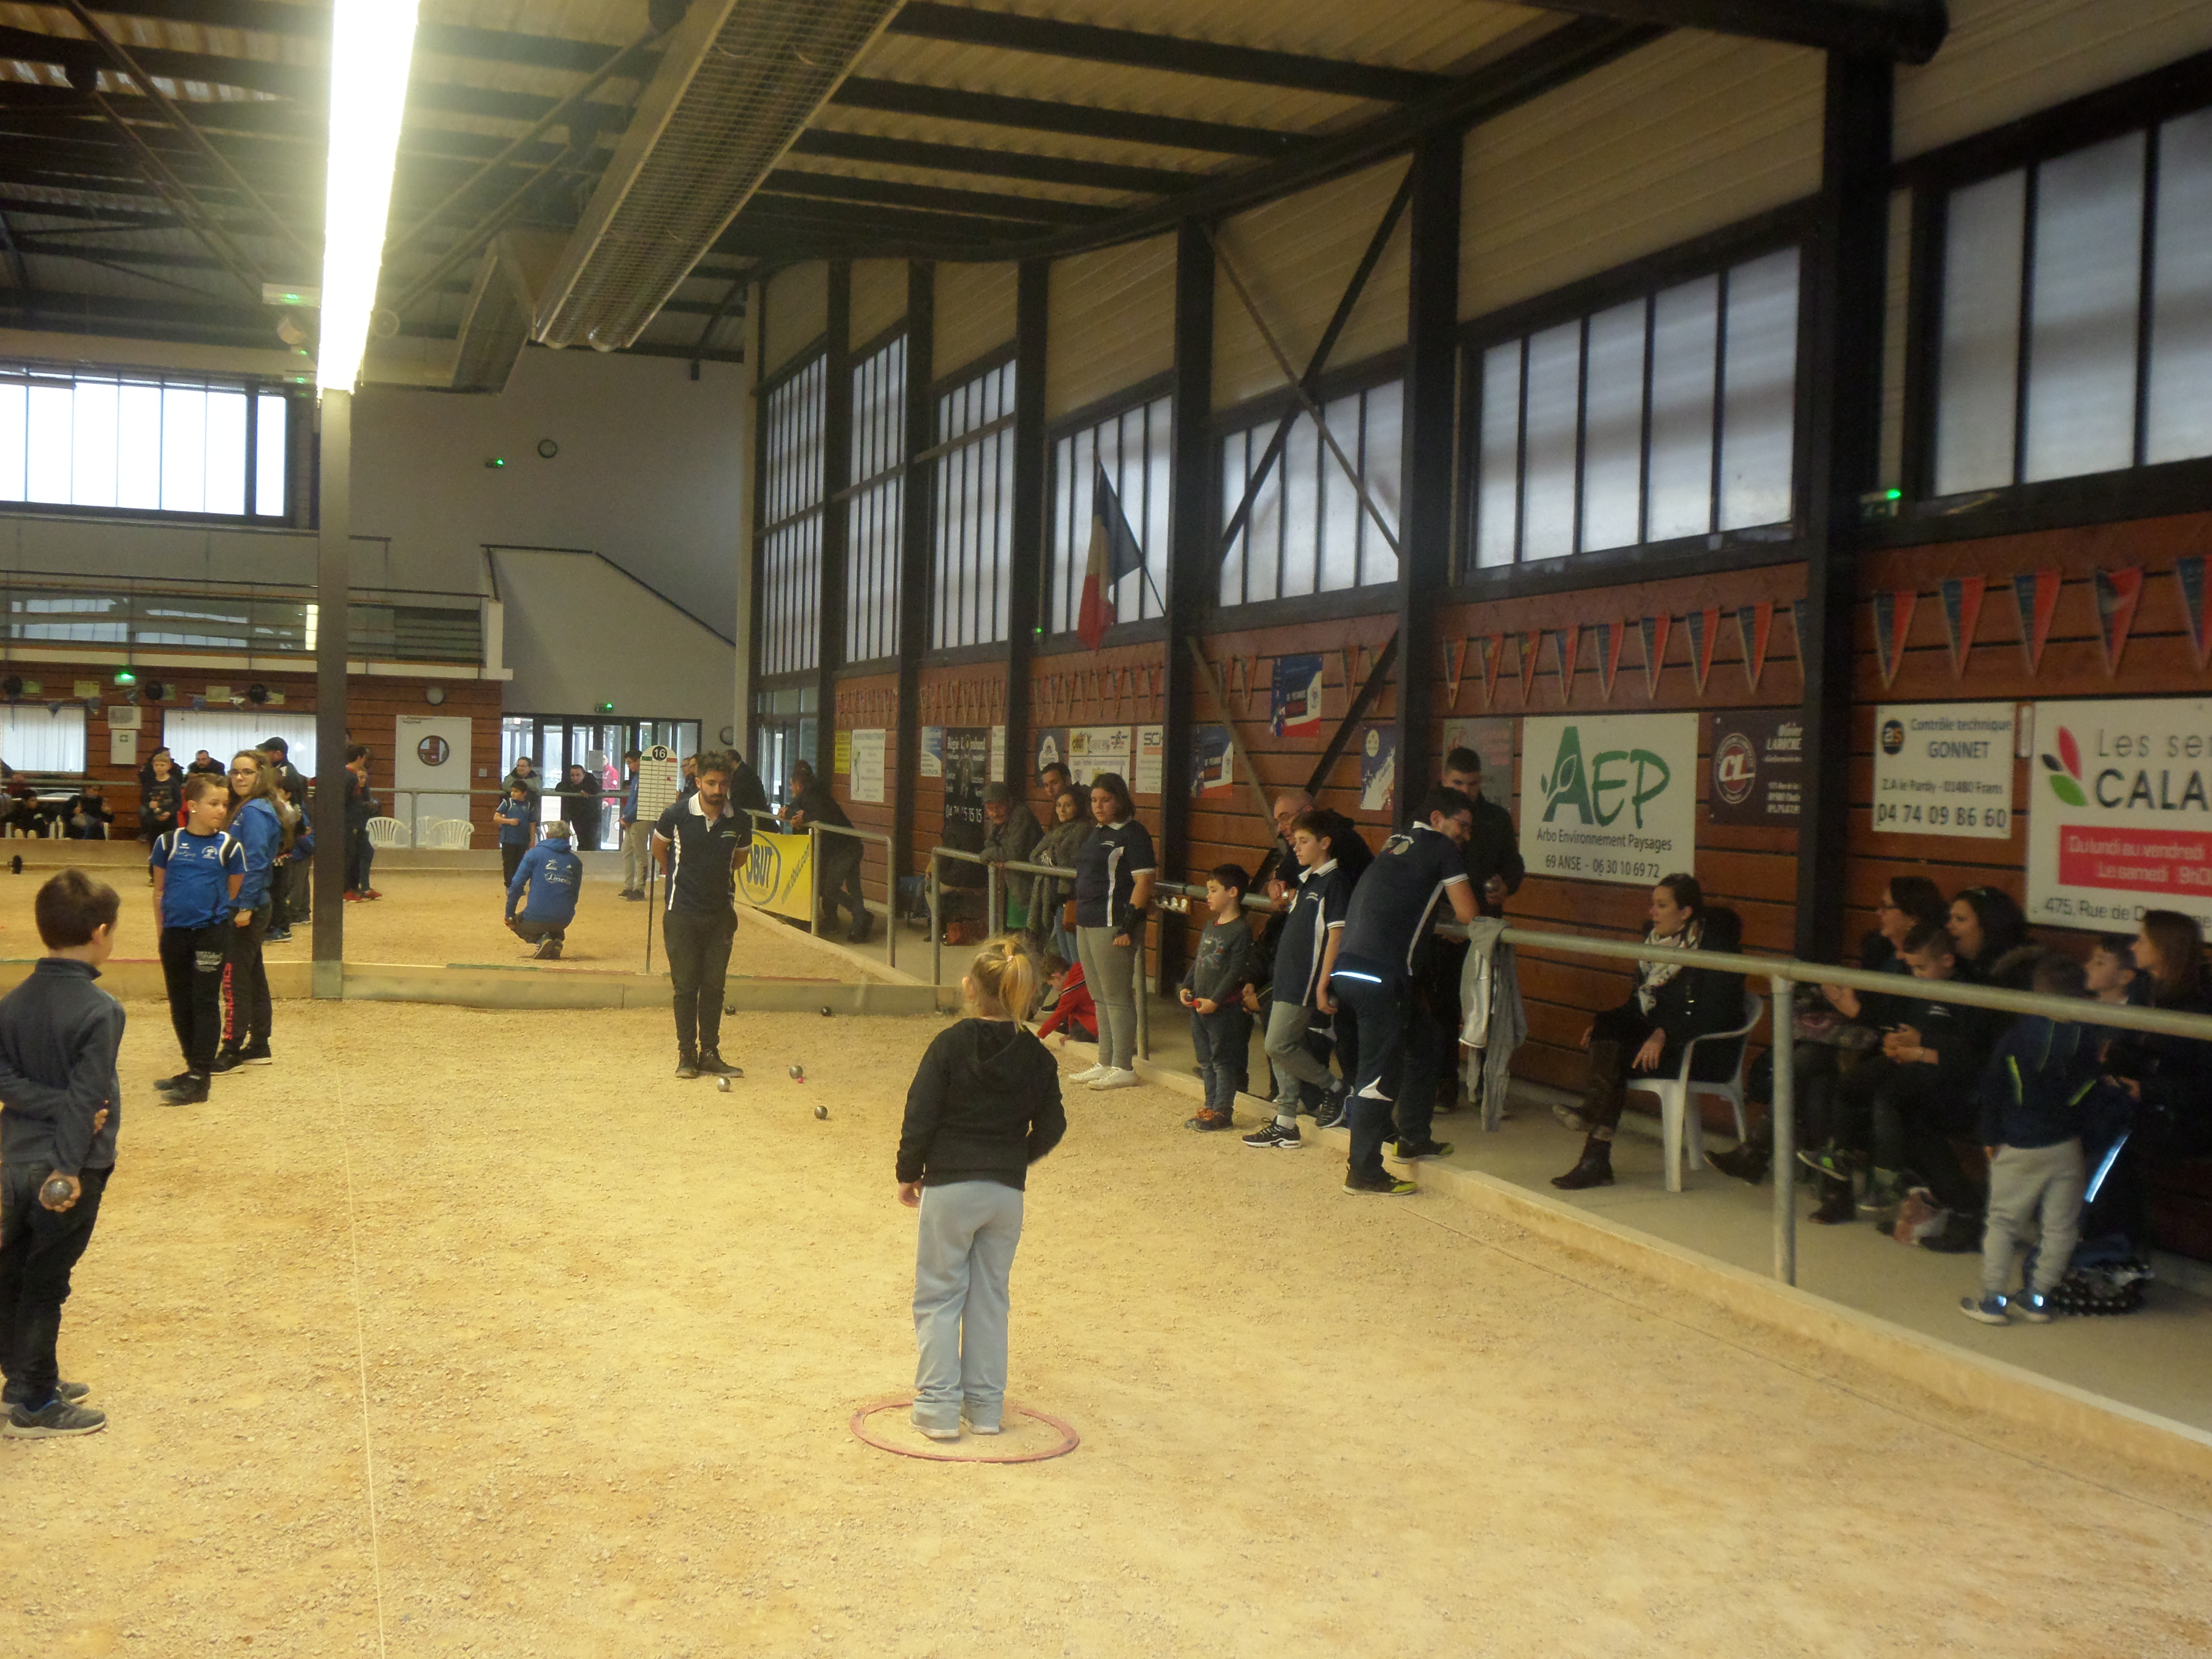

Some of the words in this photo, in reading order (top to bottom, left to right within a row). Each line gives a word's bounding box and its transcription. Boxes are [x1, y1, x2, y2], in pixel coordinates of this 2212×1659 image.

[1911, 717, 1954, 731] Contrôle
[1957, 720, 2013, 733] technique
[654, 749, 666, 758] 16
[1928, 741, 1991, 758] GONNET
[2099, 728, 2149, 757] Les
[2167, 734, 2212, 757] se
[1541, 726, 1671, 829] AEP
[1878, 804, 1897, 822] 04
[1903, 804, 1922, 823] 74
[1929, 805, 1949, 825] 09
[1957, 807, 1977, 827] 86
[1984, 808, 2007, 828] 60
[1538, 828, 1557, 842] Arbo
[1559, 829, 1626, 847] Environnement
[1629, 834, 1672, 854] Paysages
[745, 844, 772, 888] OBUT
[1546, 855, 1556, 868] 69
[1558, 856, 1582, 871] ANSE
[1607, 860, 1618, 874] 30
[1622, 861, 1631, 875] 10
[1634, 862, 1646, 877] 69
[1648, 864, 1660, 878] 72
[2080, 900, 2107, 918] Rue
[2112, 903, 2130, 920] de
